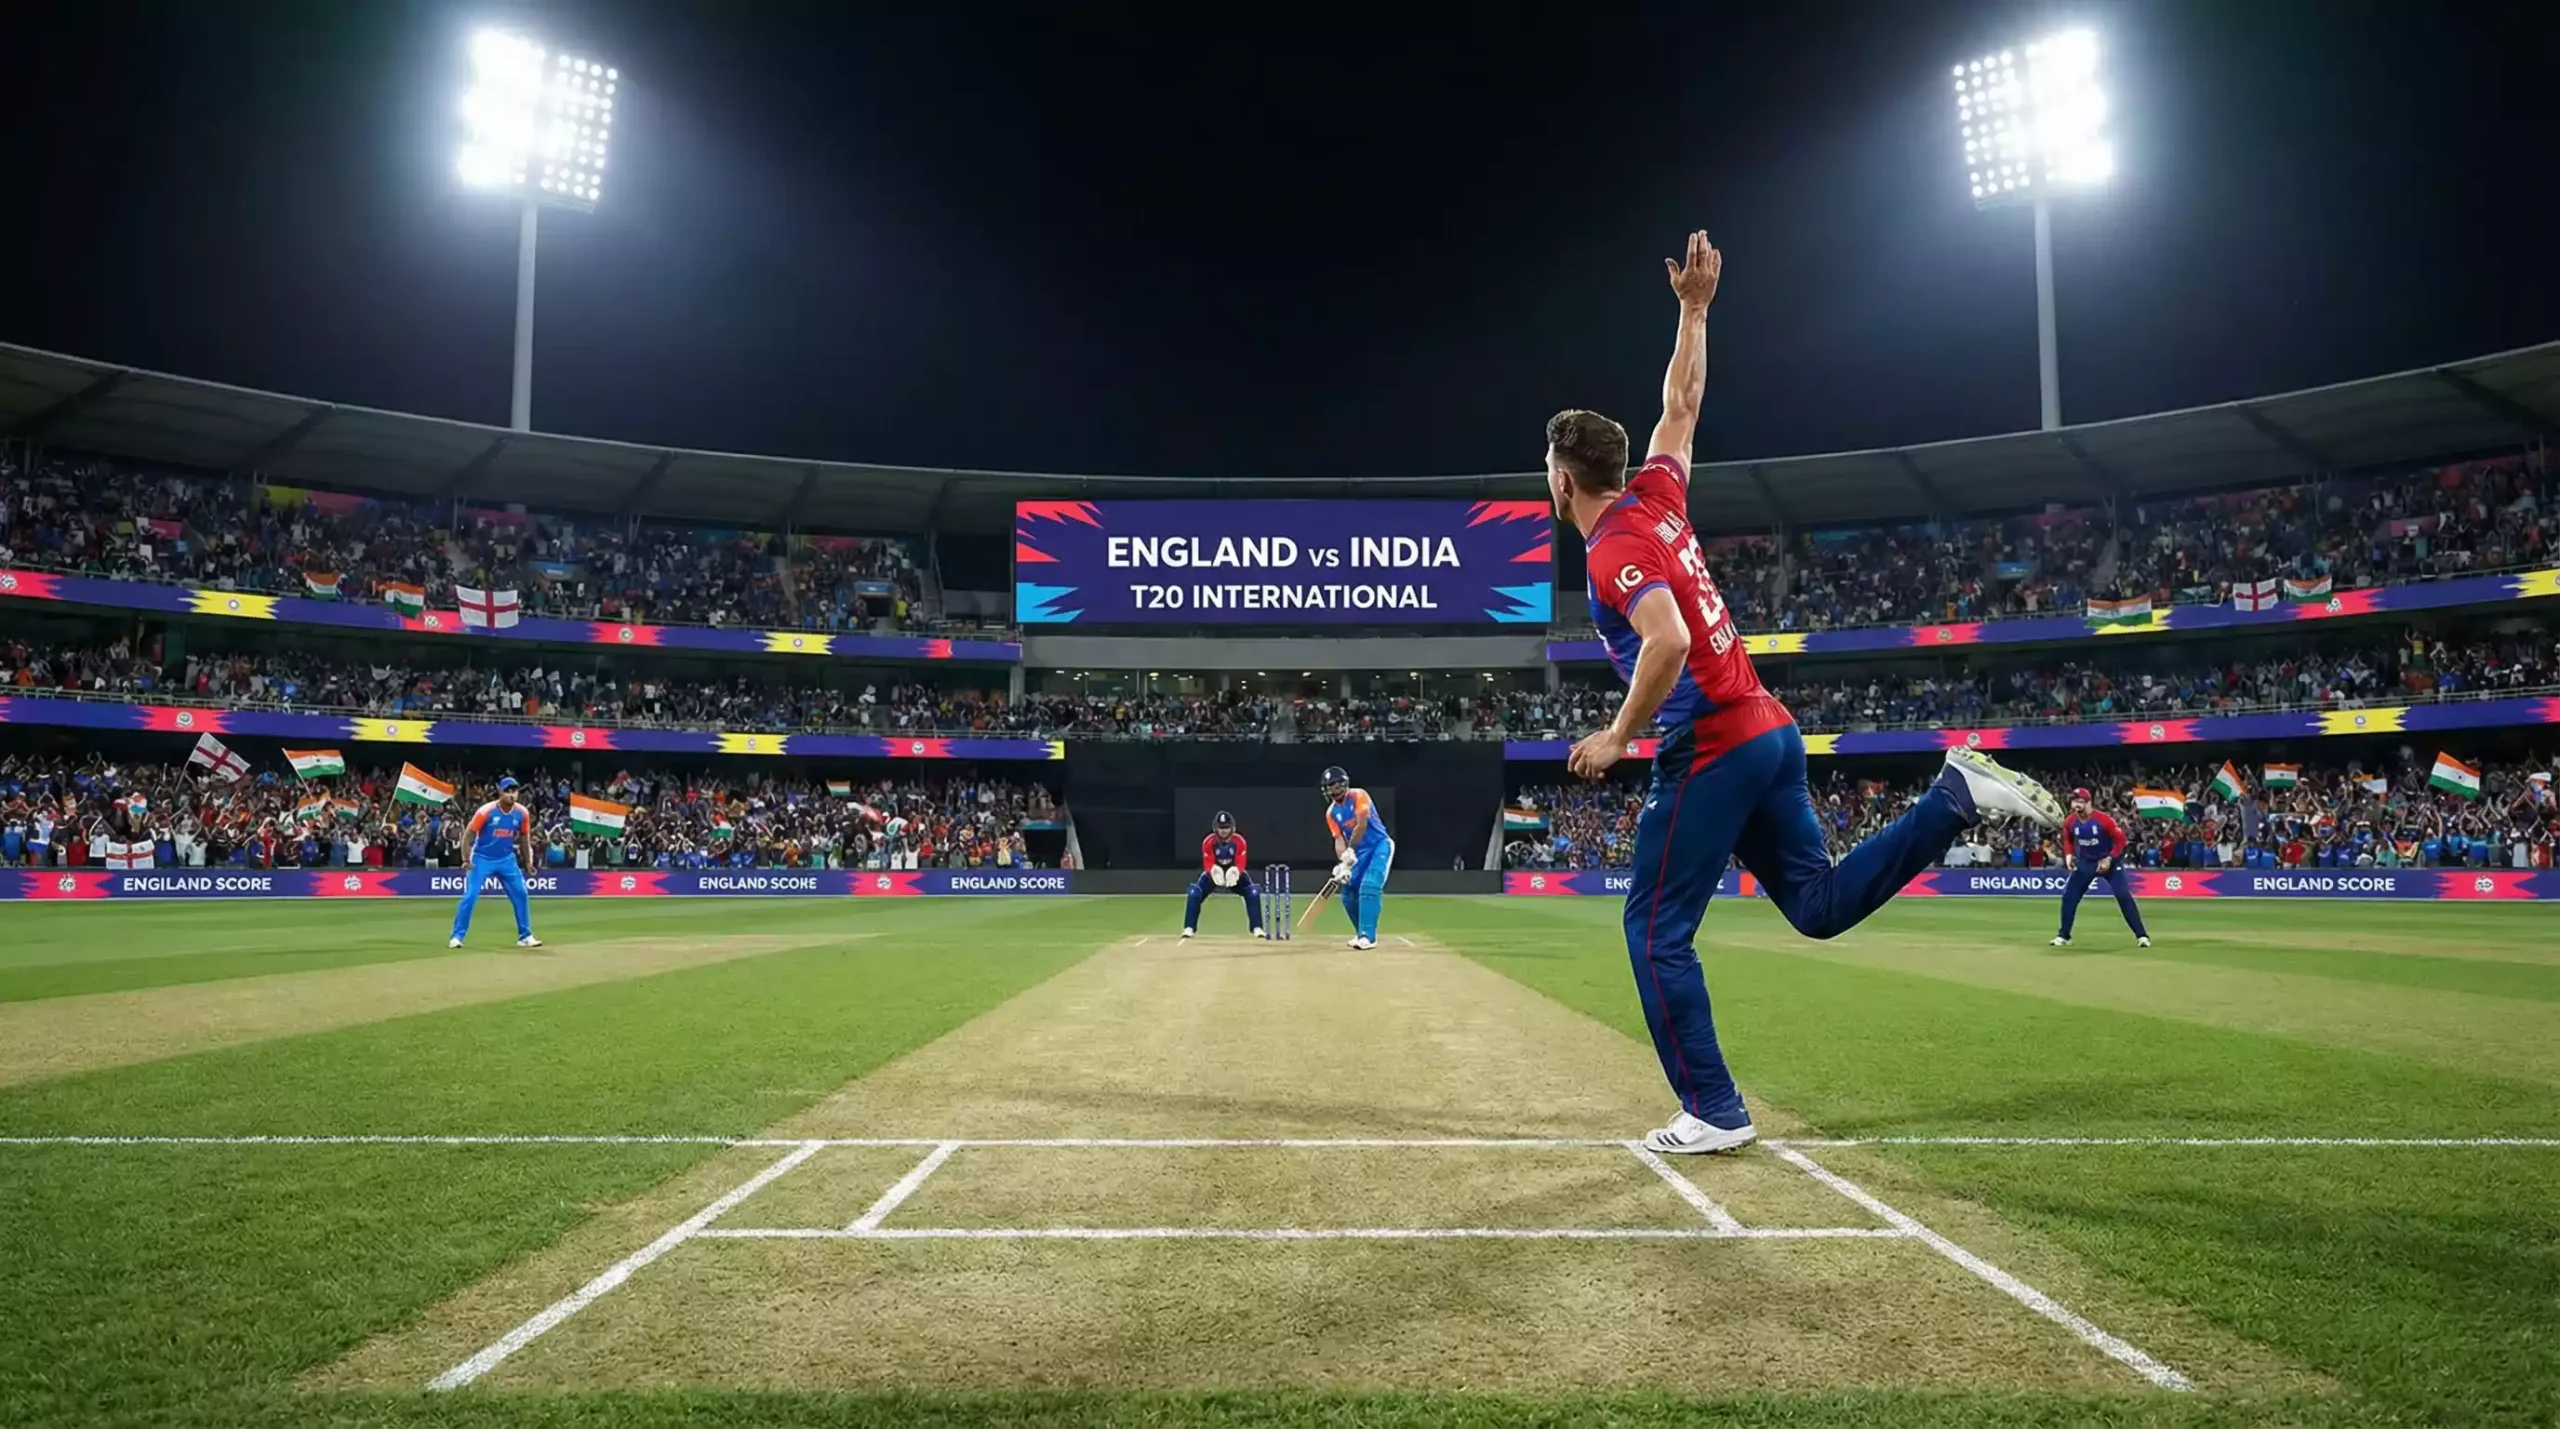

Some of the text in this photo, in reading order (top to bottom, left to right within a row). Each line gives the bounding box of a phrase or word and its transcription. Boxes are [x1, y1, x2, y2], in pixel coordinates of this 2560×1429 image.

[1107, 536, 1298, 568] ENGLAND
[1350, 536, 1461, 568] INDIA
[1614, 564, 1645, 593] IG
[1130, 584, 1438, 609] T20 INTERNATIONAL
[215, 877, 272, 891] SCORE
[699, 877, 768, 890] ENGLAND
[951, 877, 1065, 890] ENGLAND SCORE
[1970, 877, 2043, 890] ENGLAND
[2253, 877, 2396, 891] ENGLAND SCORE
